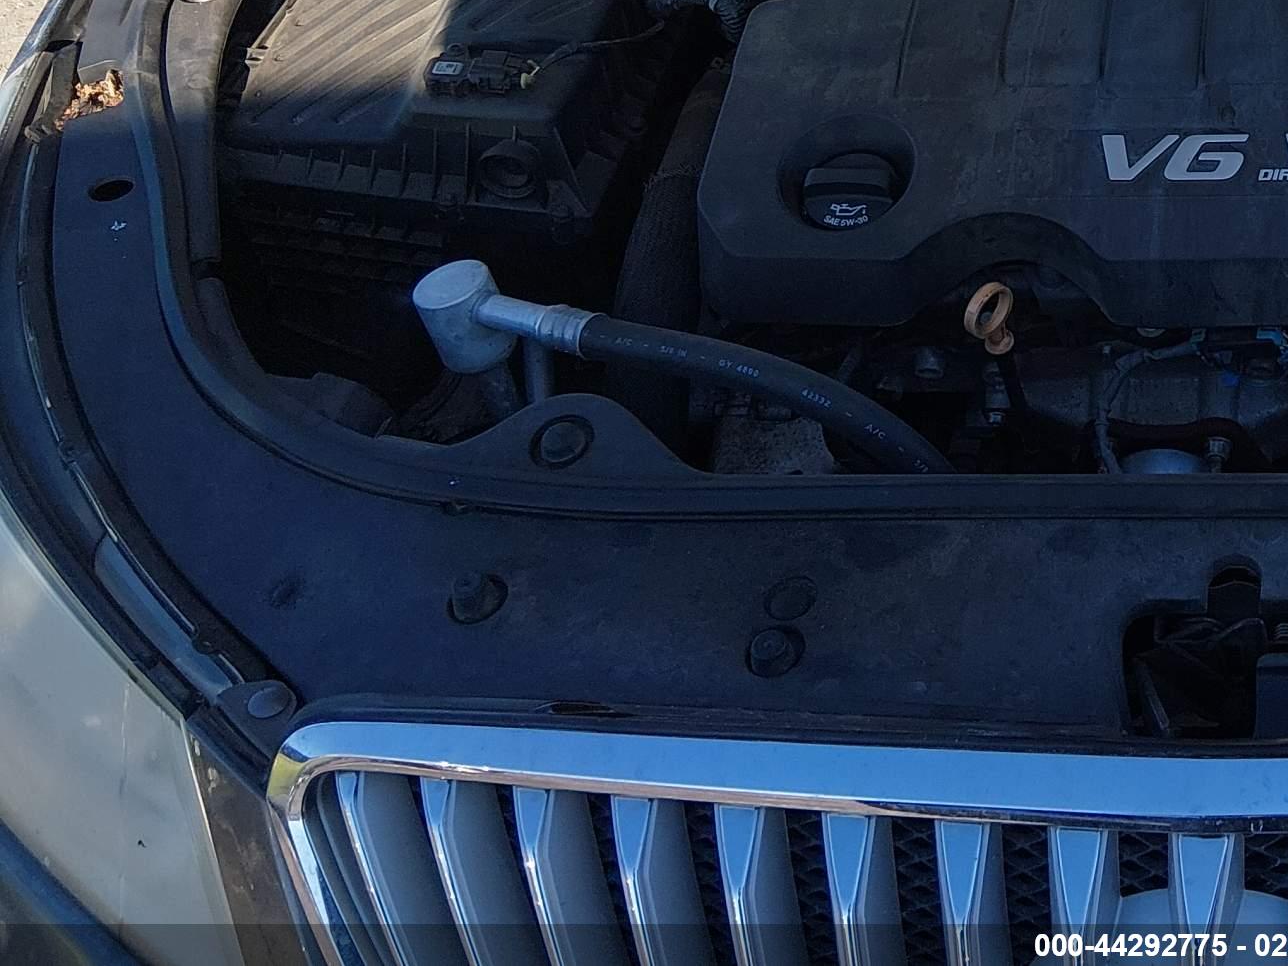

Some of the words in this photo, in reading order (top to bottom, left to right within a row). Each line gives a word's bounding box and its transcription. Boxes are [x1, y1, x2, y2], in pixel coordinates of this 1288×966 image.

[1101, 132, 1249, 182] V6
[824, 215, 840, 226] SAE
[841, 215, 868, 226] 5W-30
[864, 424, 886, 440] A/C
